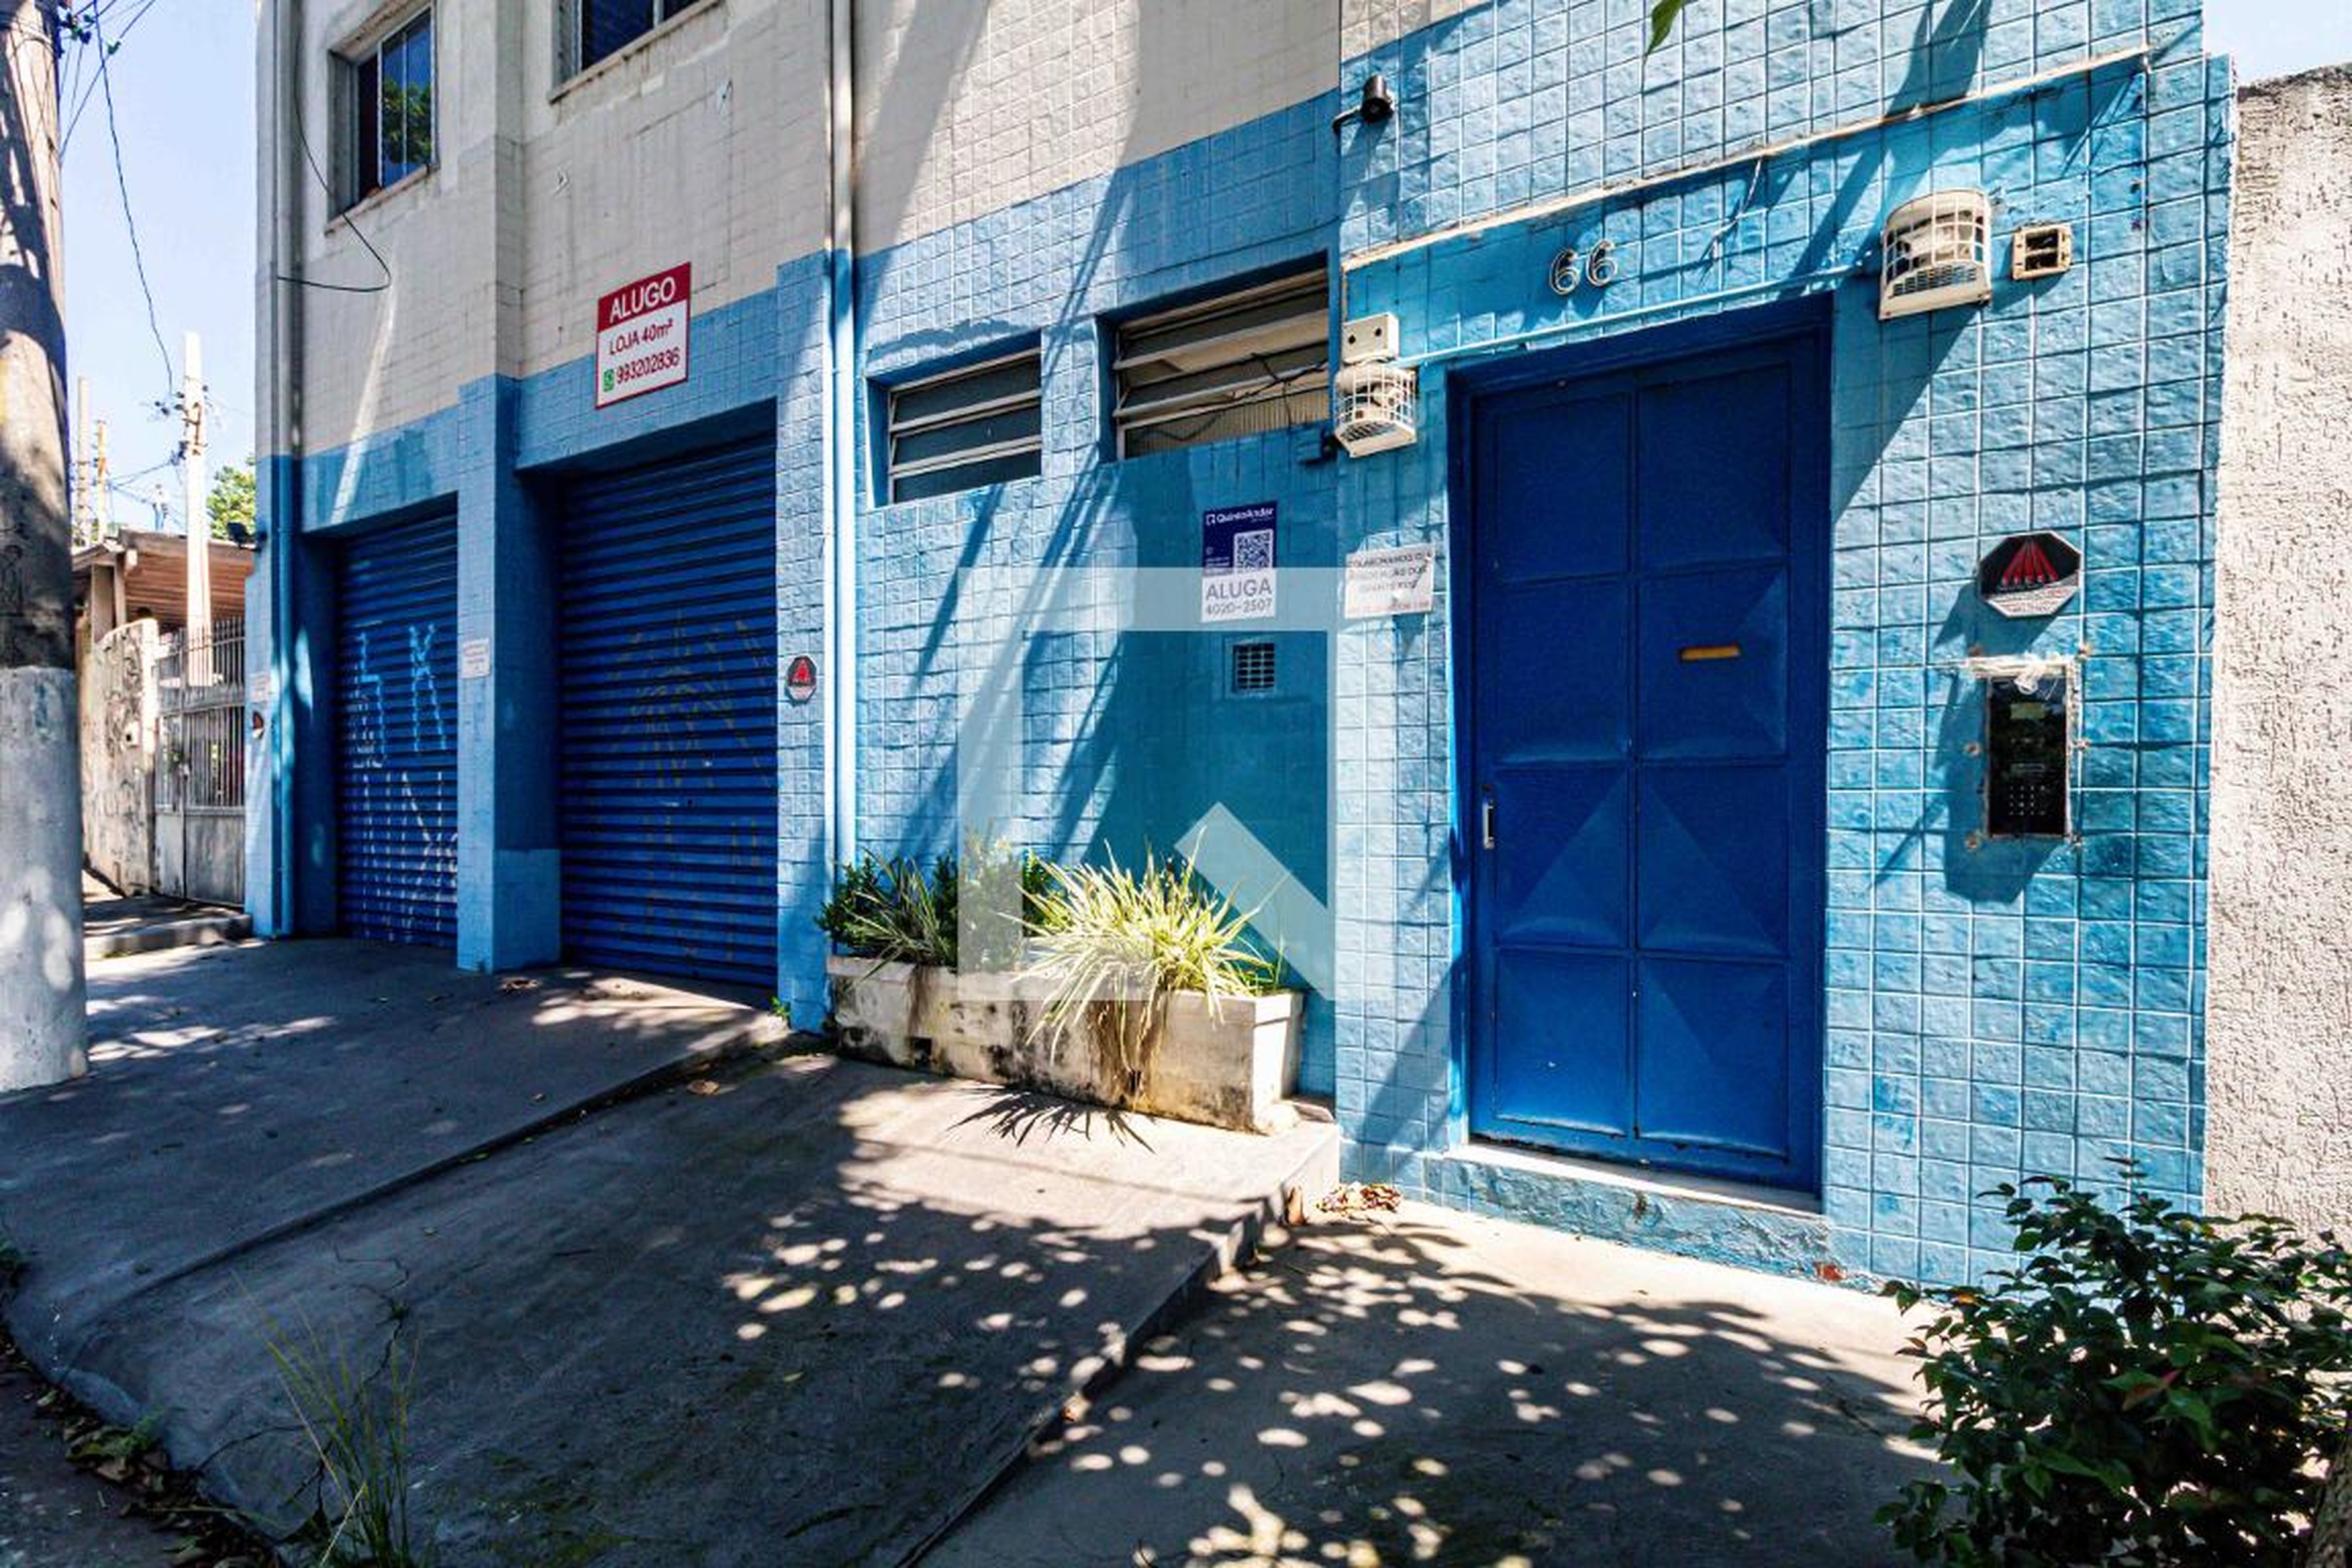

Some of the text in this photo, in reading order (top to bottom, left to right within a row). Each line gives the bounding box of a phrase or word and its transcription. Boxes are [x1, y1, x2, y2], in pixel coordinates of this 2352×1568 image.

[1549, 238, 1618, 295] 66
[609, 277, 676, 323] ALUGO
[609, 331, 640, 355] LOJA
[1205, 578, 1272, 601] ALUGA
